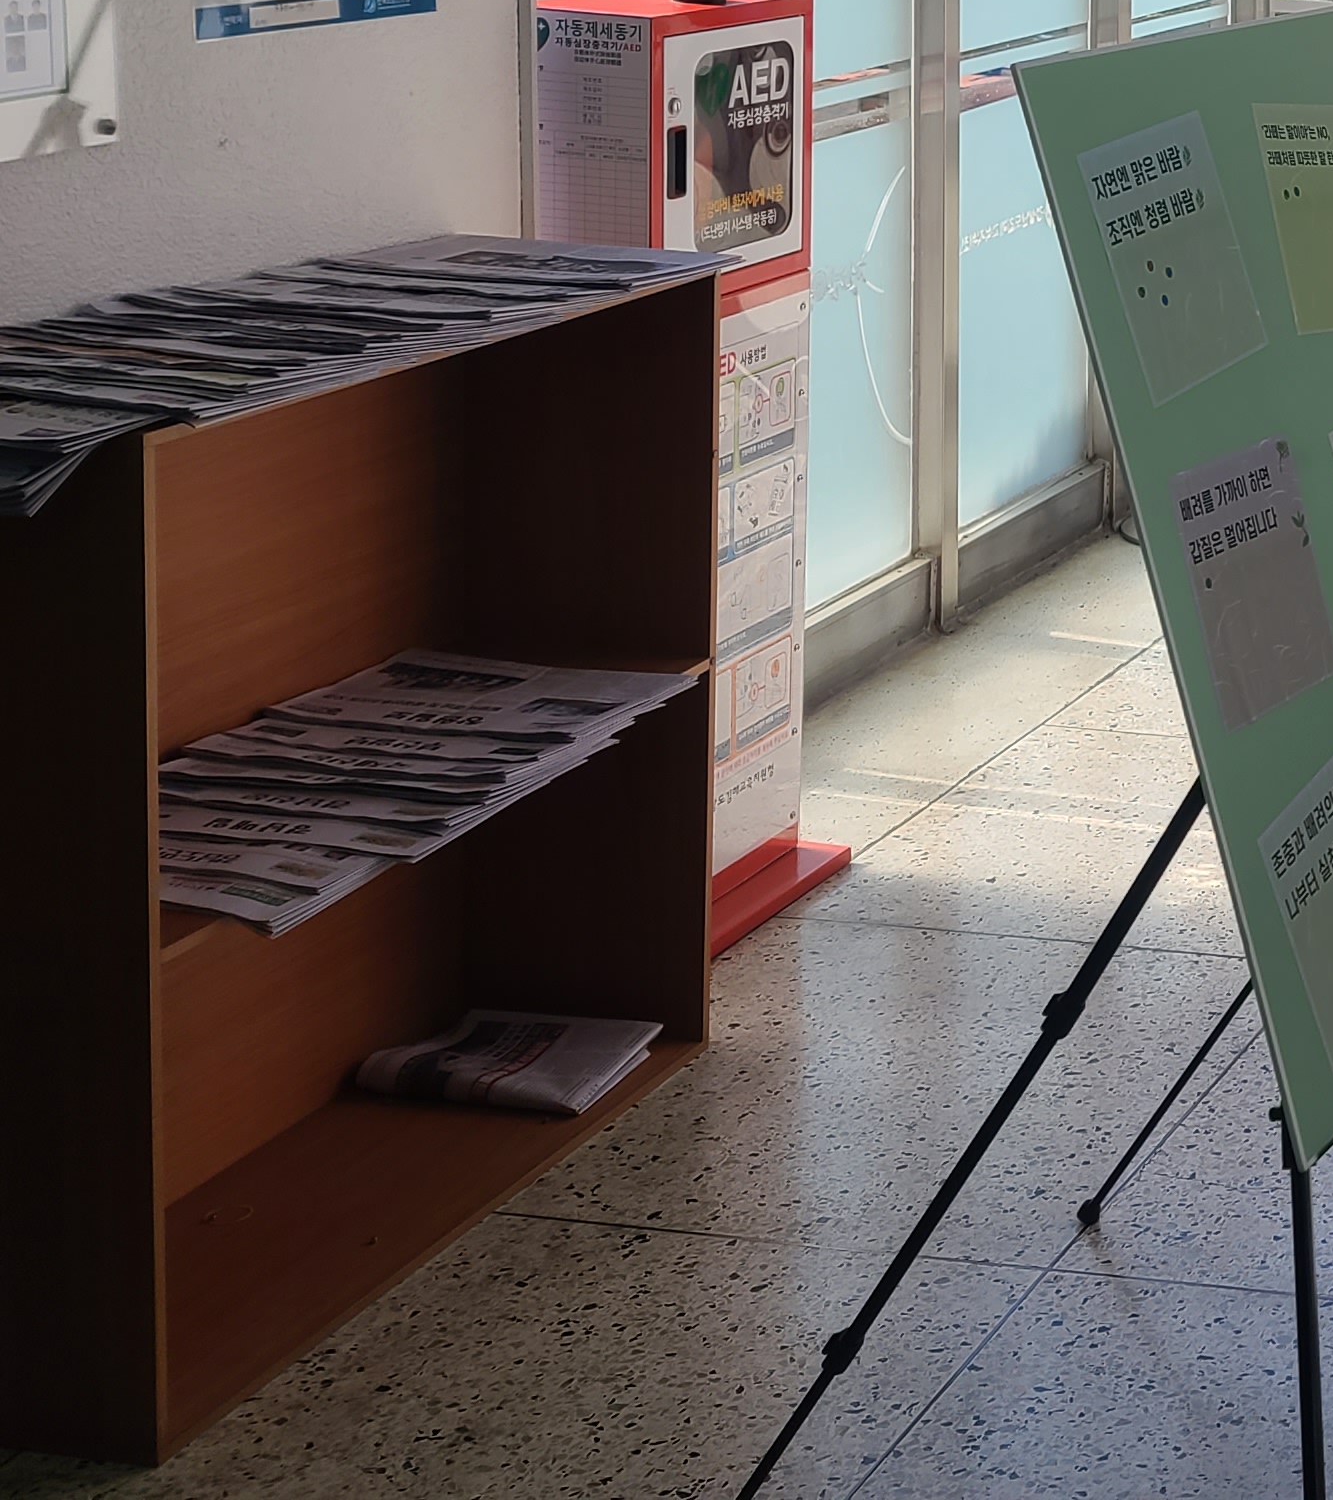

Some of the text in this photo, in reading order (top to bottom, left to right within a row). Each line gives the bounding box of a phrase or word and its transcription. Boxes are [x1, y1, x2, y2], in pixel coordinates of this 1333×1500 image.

[555, 18, 642, 42] 자동제세동기
[555, 37, 642, 53] 자동심장충격기/AED
[729, 58, 790, 108] AED
[727, 102, 789, 129] 자동심장충격기
[1091, 145, 1183, 200] 자연엔 맑은 바람
[1267, 151, 1296, 166] 라떼처럼
[1296, 151, 1318, 165] 따뜻한
[1318, 151, 1327, 166] 말
[766, 184, 784, 203] 사용
[731, 212, 752, 235] 시스템
[1106, 188, 1196, 246] 조직엔 청렴 바람
[740, 344, 767, 366] 사용방법
[1178, 466, 1272, 522] 배려를 가까이 하면
[1188, 506, 1279, 565] 갑질은 멀어집니다
[1270, 826, 1307, 880] 존중과
[1283, 866, 1320, 921] 나부터
